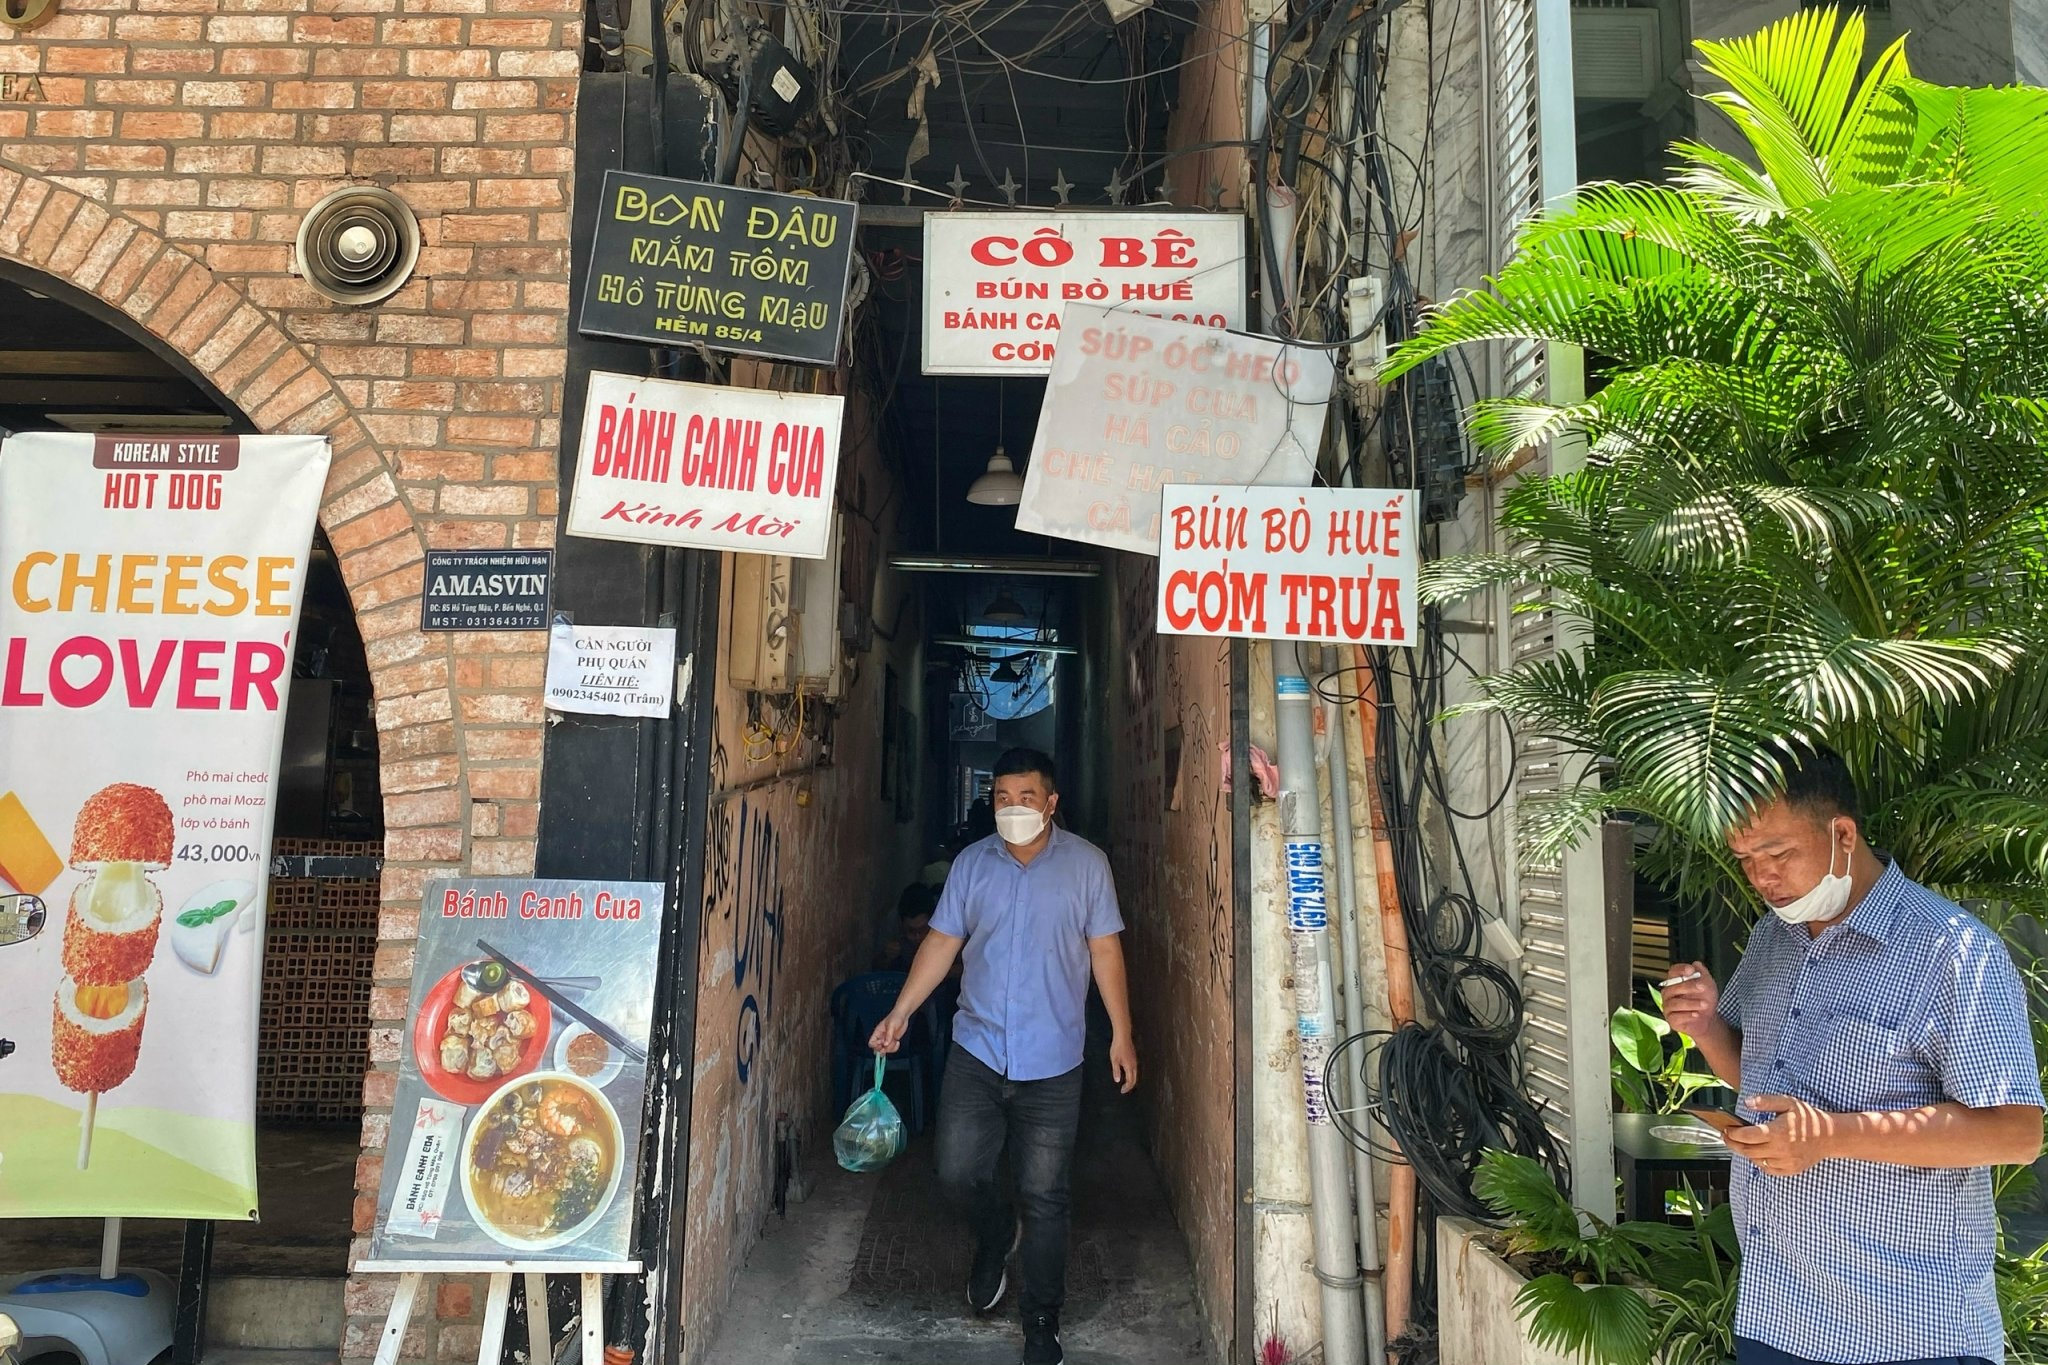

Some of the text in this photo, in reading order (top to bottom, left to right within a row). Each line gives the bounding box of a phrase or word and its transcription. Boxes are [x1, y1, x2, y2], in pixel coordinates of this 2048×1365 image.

[747, 206, 837, 249] ĐẬU
[630, 235, 809, 286] MẮM TÔM
[970, 227, 1198, 269] CÔ BÊ
[976, 275, 1194, 301] BÚN BÒ HUẾ
[656, 315, 763, 343] HẺM 85/4
[944, 307, 1017, 330] BÁNH
[1225, 350, 1301, 387] HEO
[1186, 386, 1259, 423] CUA
[113, 443, 220, 464] KOREAN STYLE
[592, 393, 826, 498] BÁNH CANH CUA
[104, 473, 223, 510] HOT DOG
[600, 501, 802, 538] Kính Mời
[1171, 496, 1249, 552] BÚN
[1261, 497, 1312, 554] BÒ
[1328, 495, 1406, 558] HUẾ
[431, 556, 548, 567] CÔNG TY TRÁCH NHIỆM HỮU HẠN
[12, 551, 296, 617] CHEESE
[429, 574, 547, 597] AMASVIN
[441, 604, 451, 612] 85
[494, 604, 501, 612] P.
[1165, 559, 1406, 641] CƠM TRƯA
[466, 617, 540, 626] 0313643175
[577, 656, 648, 671] PHỤ QUÁN
[580, 673, 614, 687] LIÊN
[552, 688, 665, 706] 0902345402 (Trâm)
[212, 772, 234, 783] mai
[183, 793, 266, 807] phô mai Mozz
[220, 818, 250, 829] bánh
[1291, 870, 1325, 893] 997
[442, 889, 642, 920] Bánh Canh Cua
